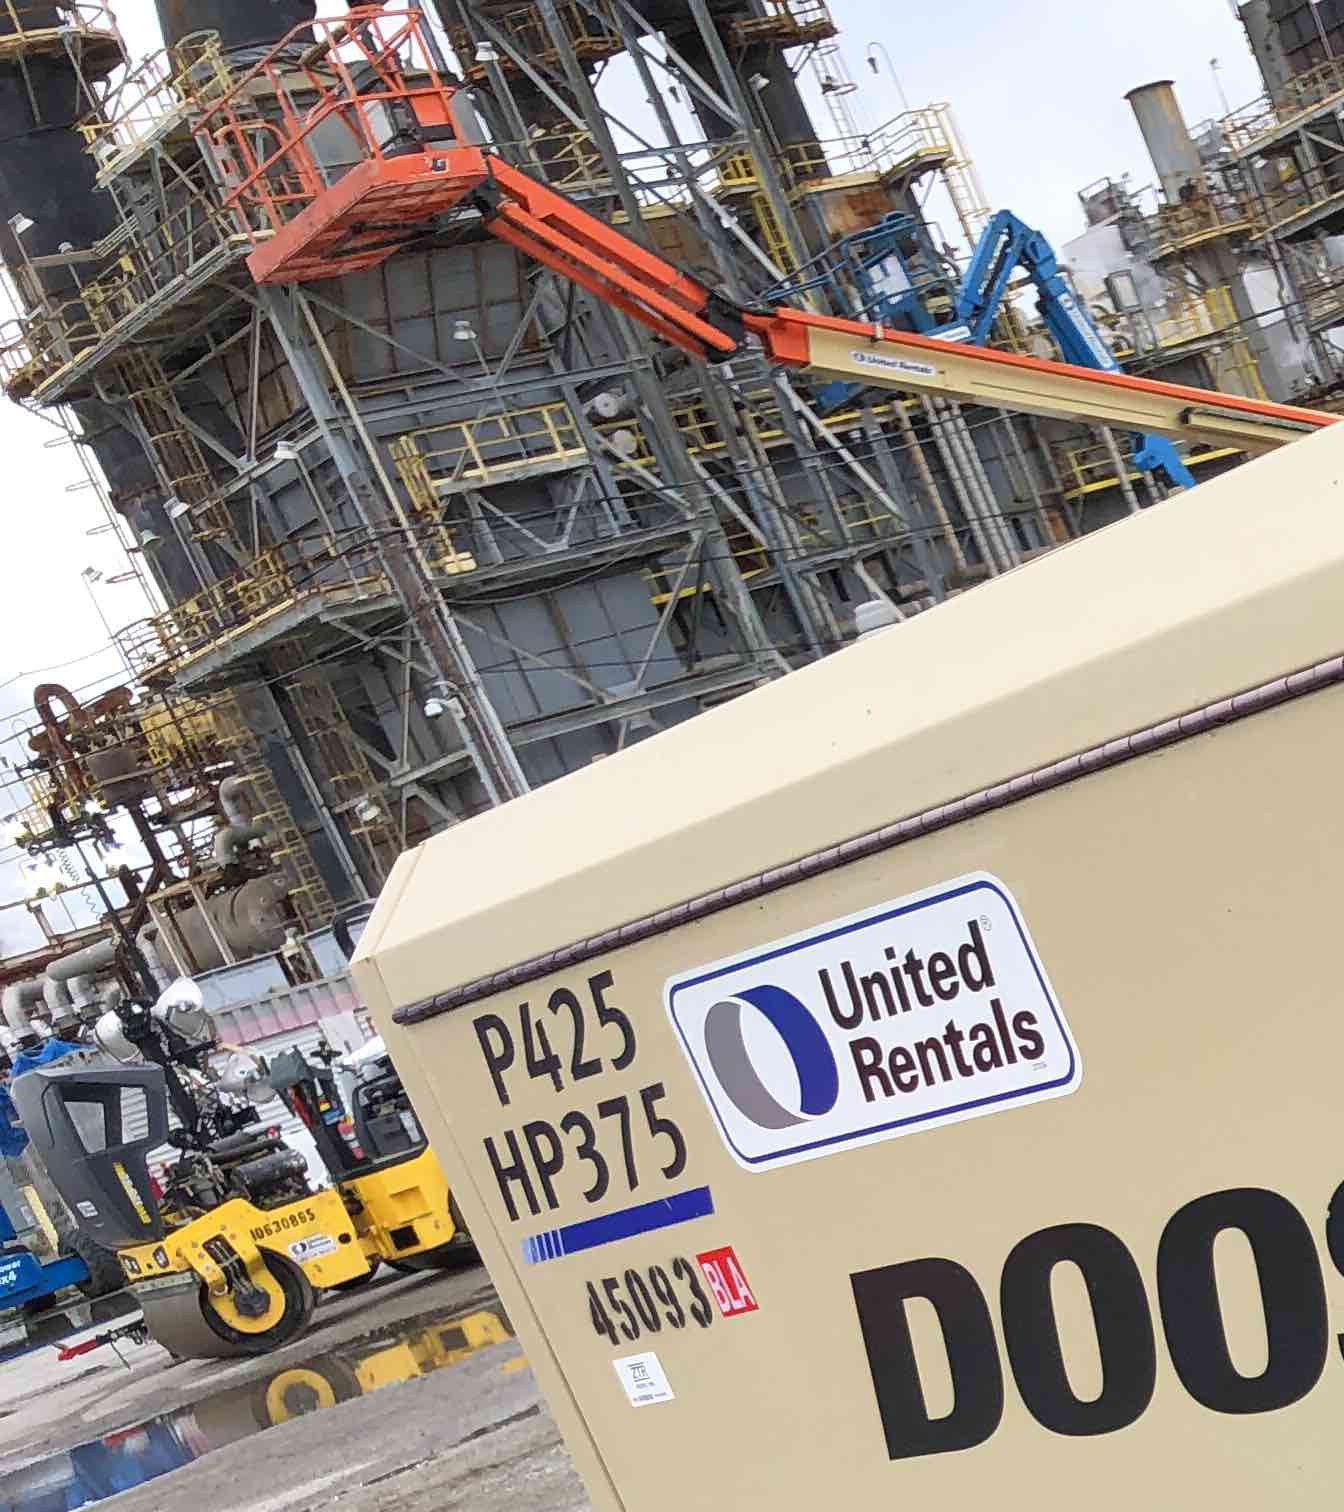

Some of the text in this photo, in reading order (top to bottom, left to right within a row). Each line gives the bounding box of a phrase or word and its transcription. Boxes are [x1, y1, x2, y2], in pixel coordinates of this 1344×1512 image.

[818, 919, 996, 1030] United
[472, 969, 637, 1107] P425
[849, 998, 1046, 1103] Rentals
[483, 1082, 688, 1222] HP375
[586, 1257, 714, 1347] 45093
[701, 1256, 757, 1314] BLA
